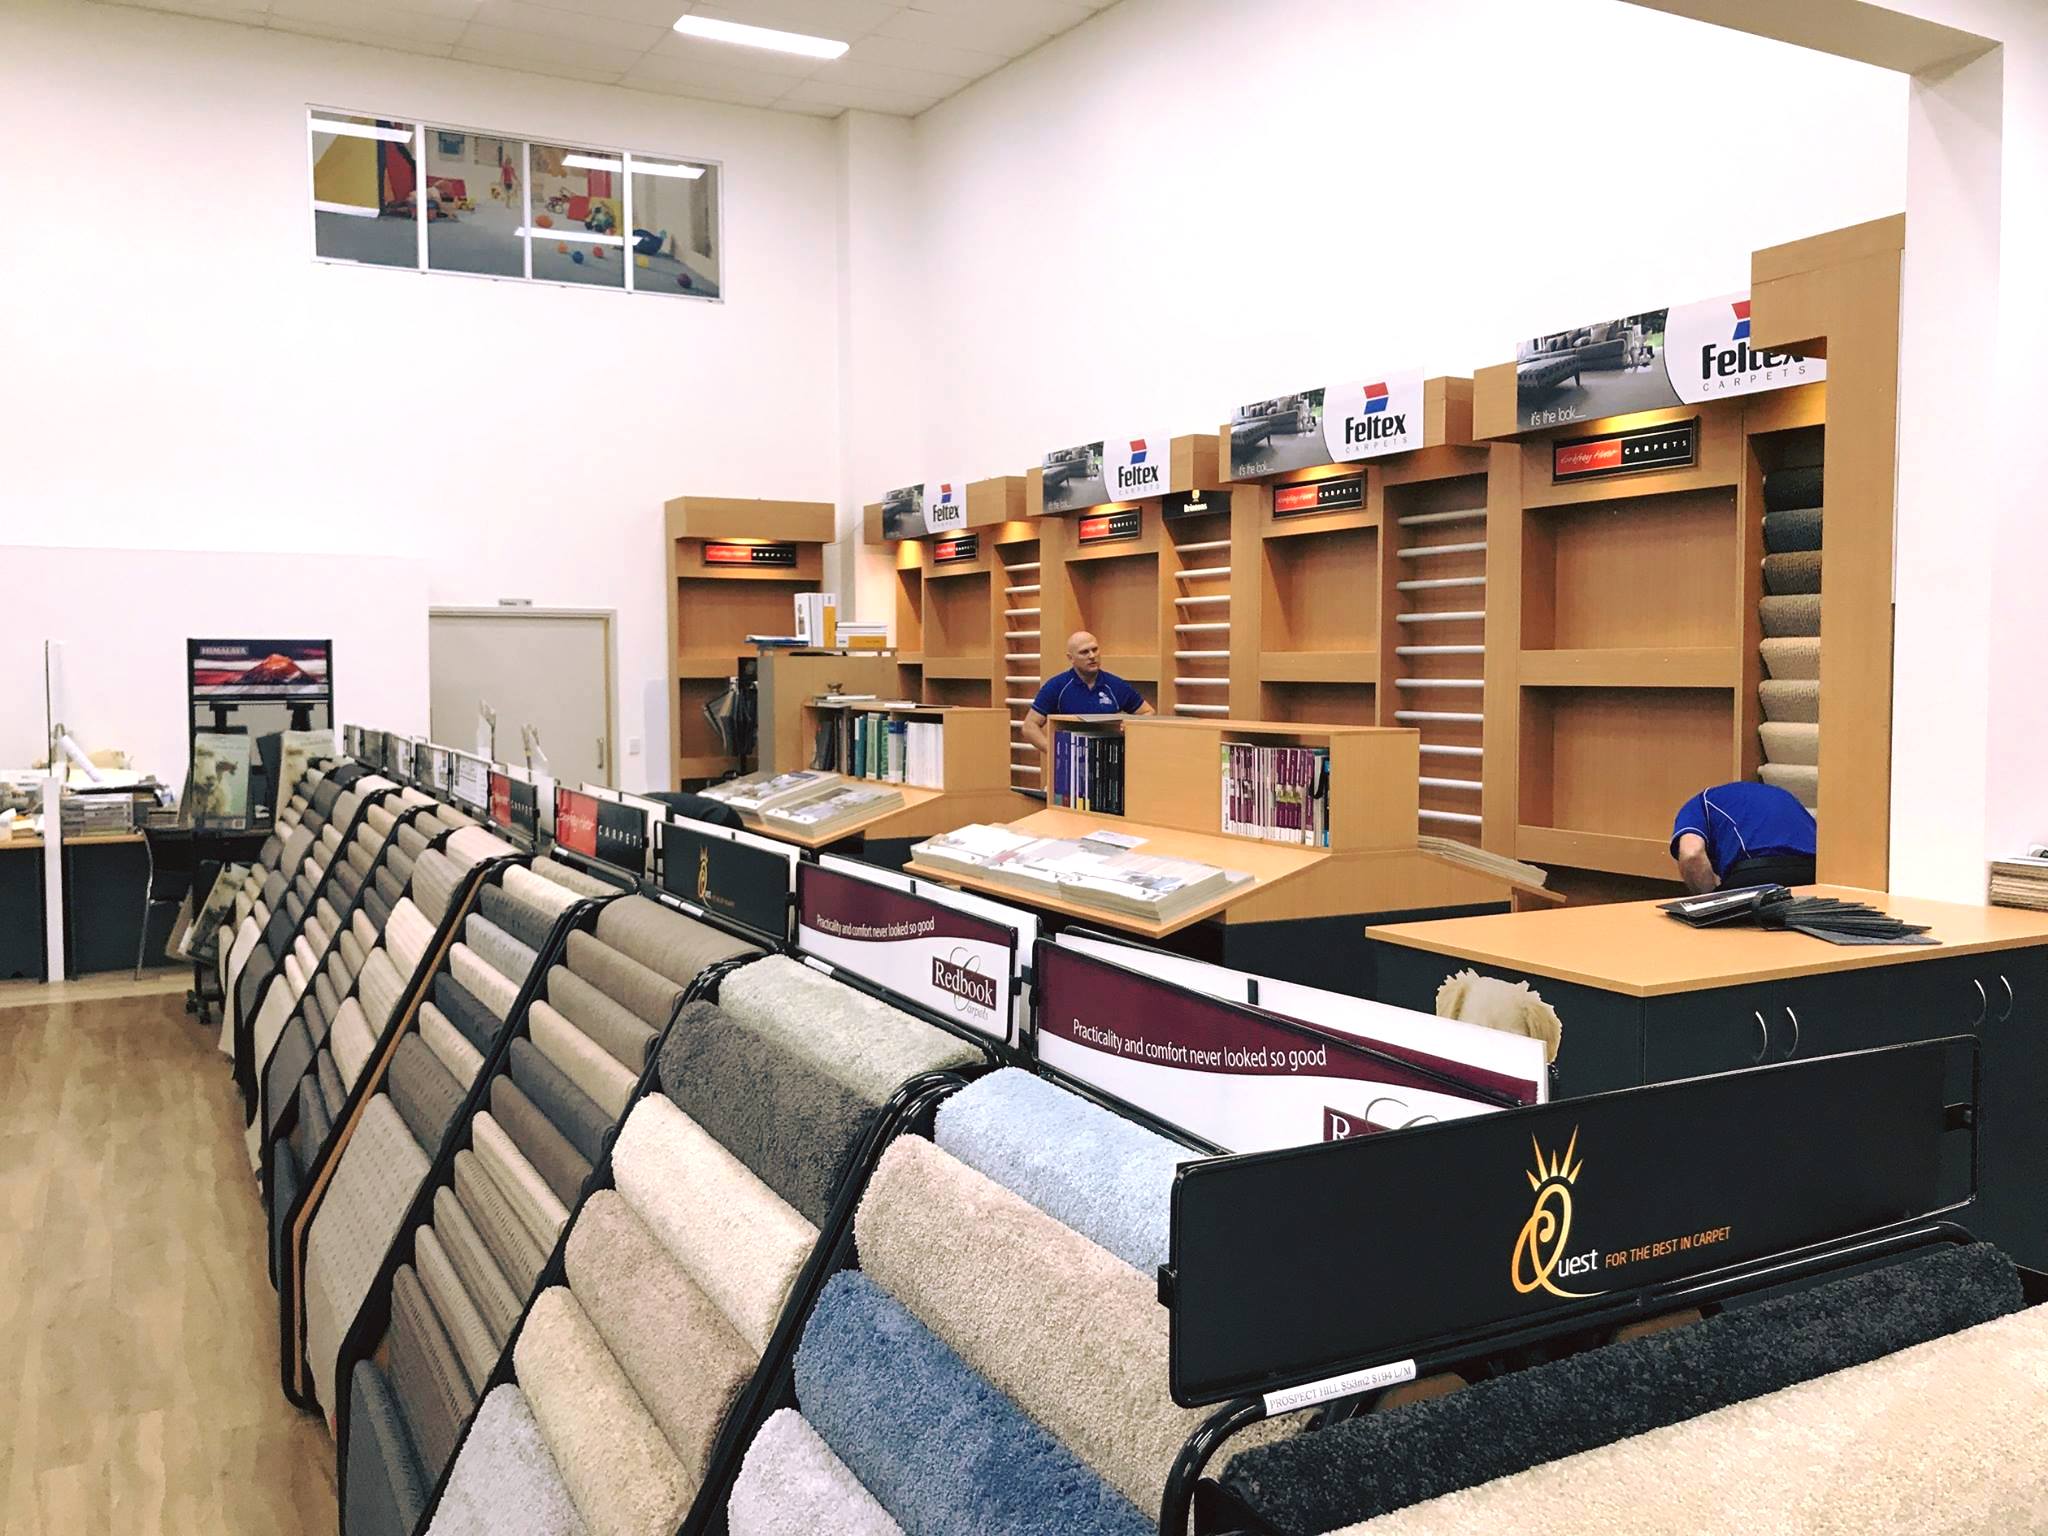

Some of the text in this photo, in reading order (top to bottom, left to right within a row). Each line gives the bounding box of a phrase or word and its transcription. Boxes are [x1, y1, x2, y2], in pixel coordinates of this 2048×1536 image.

[1702, 341, 1805, 379] Felte
[1702, 365, 1806, 392] CARPETS
[1345, 414, 1406, 444] Feltex
[1624, 440, 1687, 455] CARPETS
[1118, 465, 1159, 488] Feltex
[1319, 487, 1359, 498] CARPETS
[933, 504, 960, 522] Feltex
[842, 922, 852, 935] and
[852, 923, 872, 937] comfort
[872, 927, 888, 938] never
[888, 920, 908, 936] looked
[909, 923, 917, 935] so
[917, 915, 935, 936] good
[935, 960, 994, 1006] Redbook
[1073, 1018, 1327, 1071] Practicality and comfort never looked so good
[1605, 1226, 1732, 1269] FOR THE BEST IN CARPET
[1269, 1388, 1317, 1409] PROSPECT
[1318, 1384, 1339, 1397] HILL
[1394, 1366, 1412, 1378] L/M
